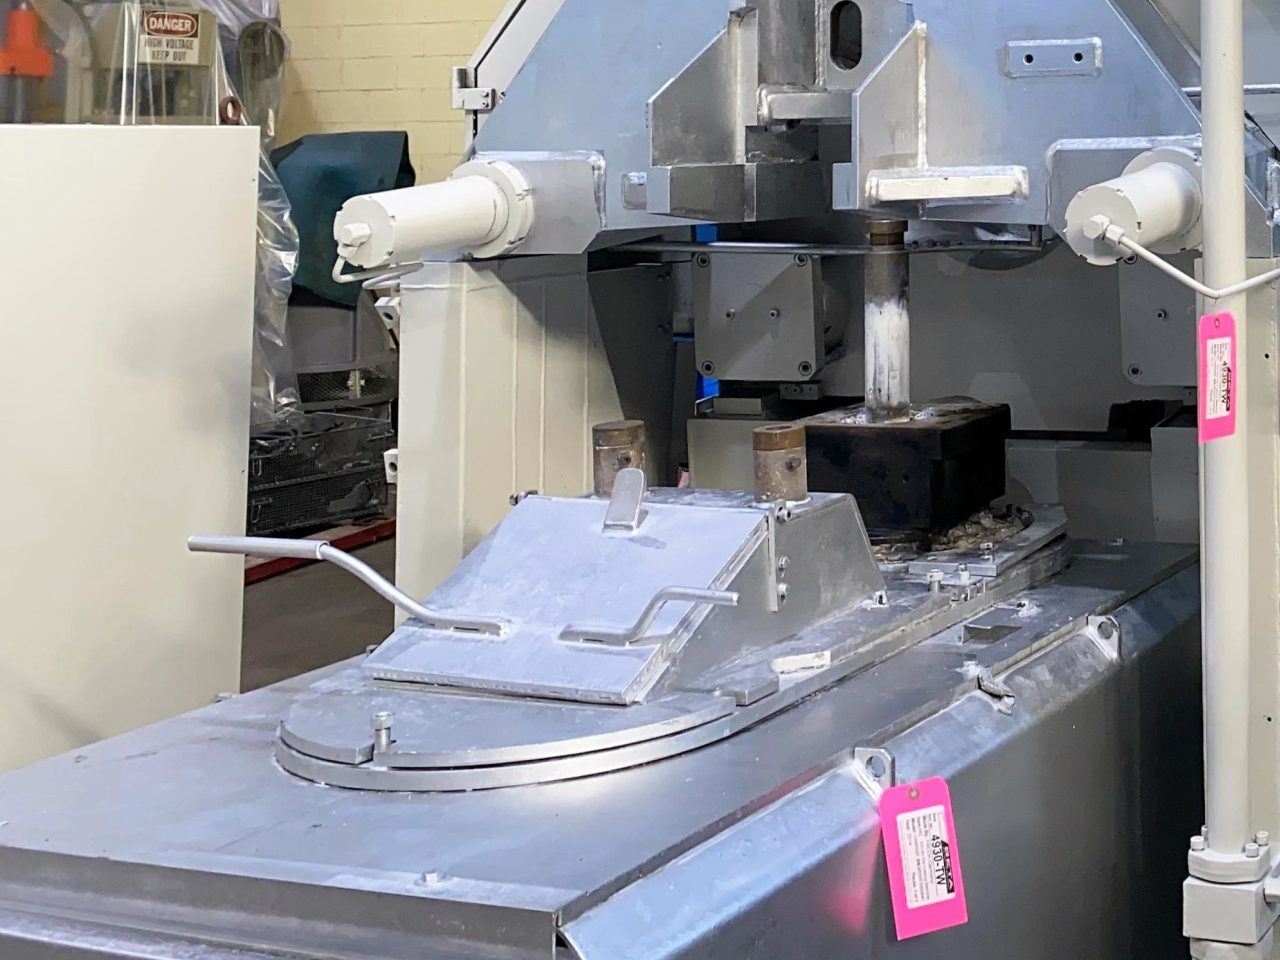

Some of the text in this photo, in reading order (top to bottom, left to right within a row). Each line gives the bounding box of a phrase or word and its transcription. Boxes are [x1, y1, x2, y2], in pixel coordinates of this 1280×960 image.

[149, 17, 192, 32] DANGER
[144, 37, 194, 50] HIGH VOLTAGE
[151, 50, 186, 61] KEEP OUT
[931, 834, 947, 885] 4930-TW
